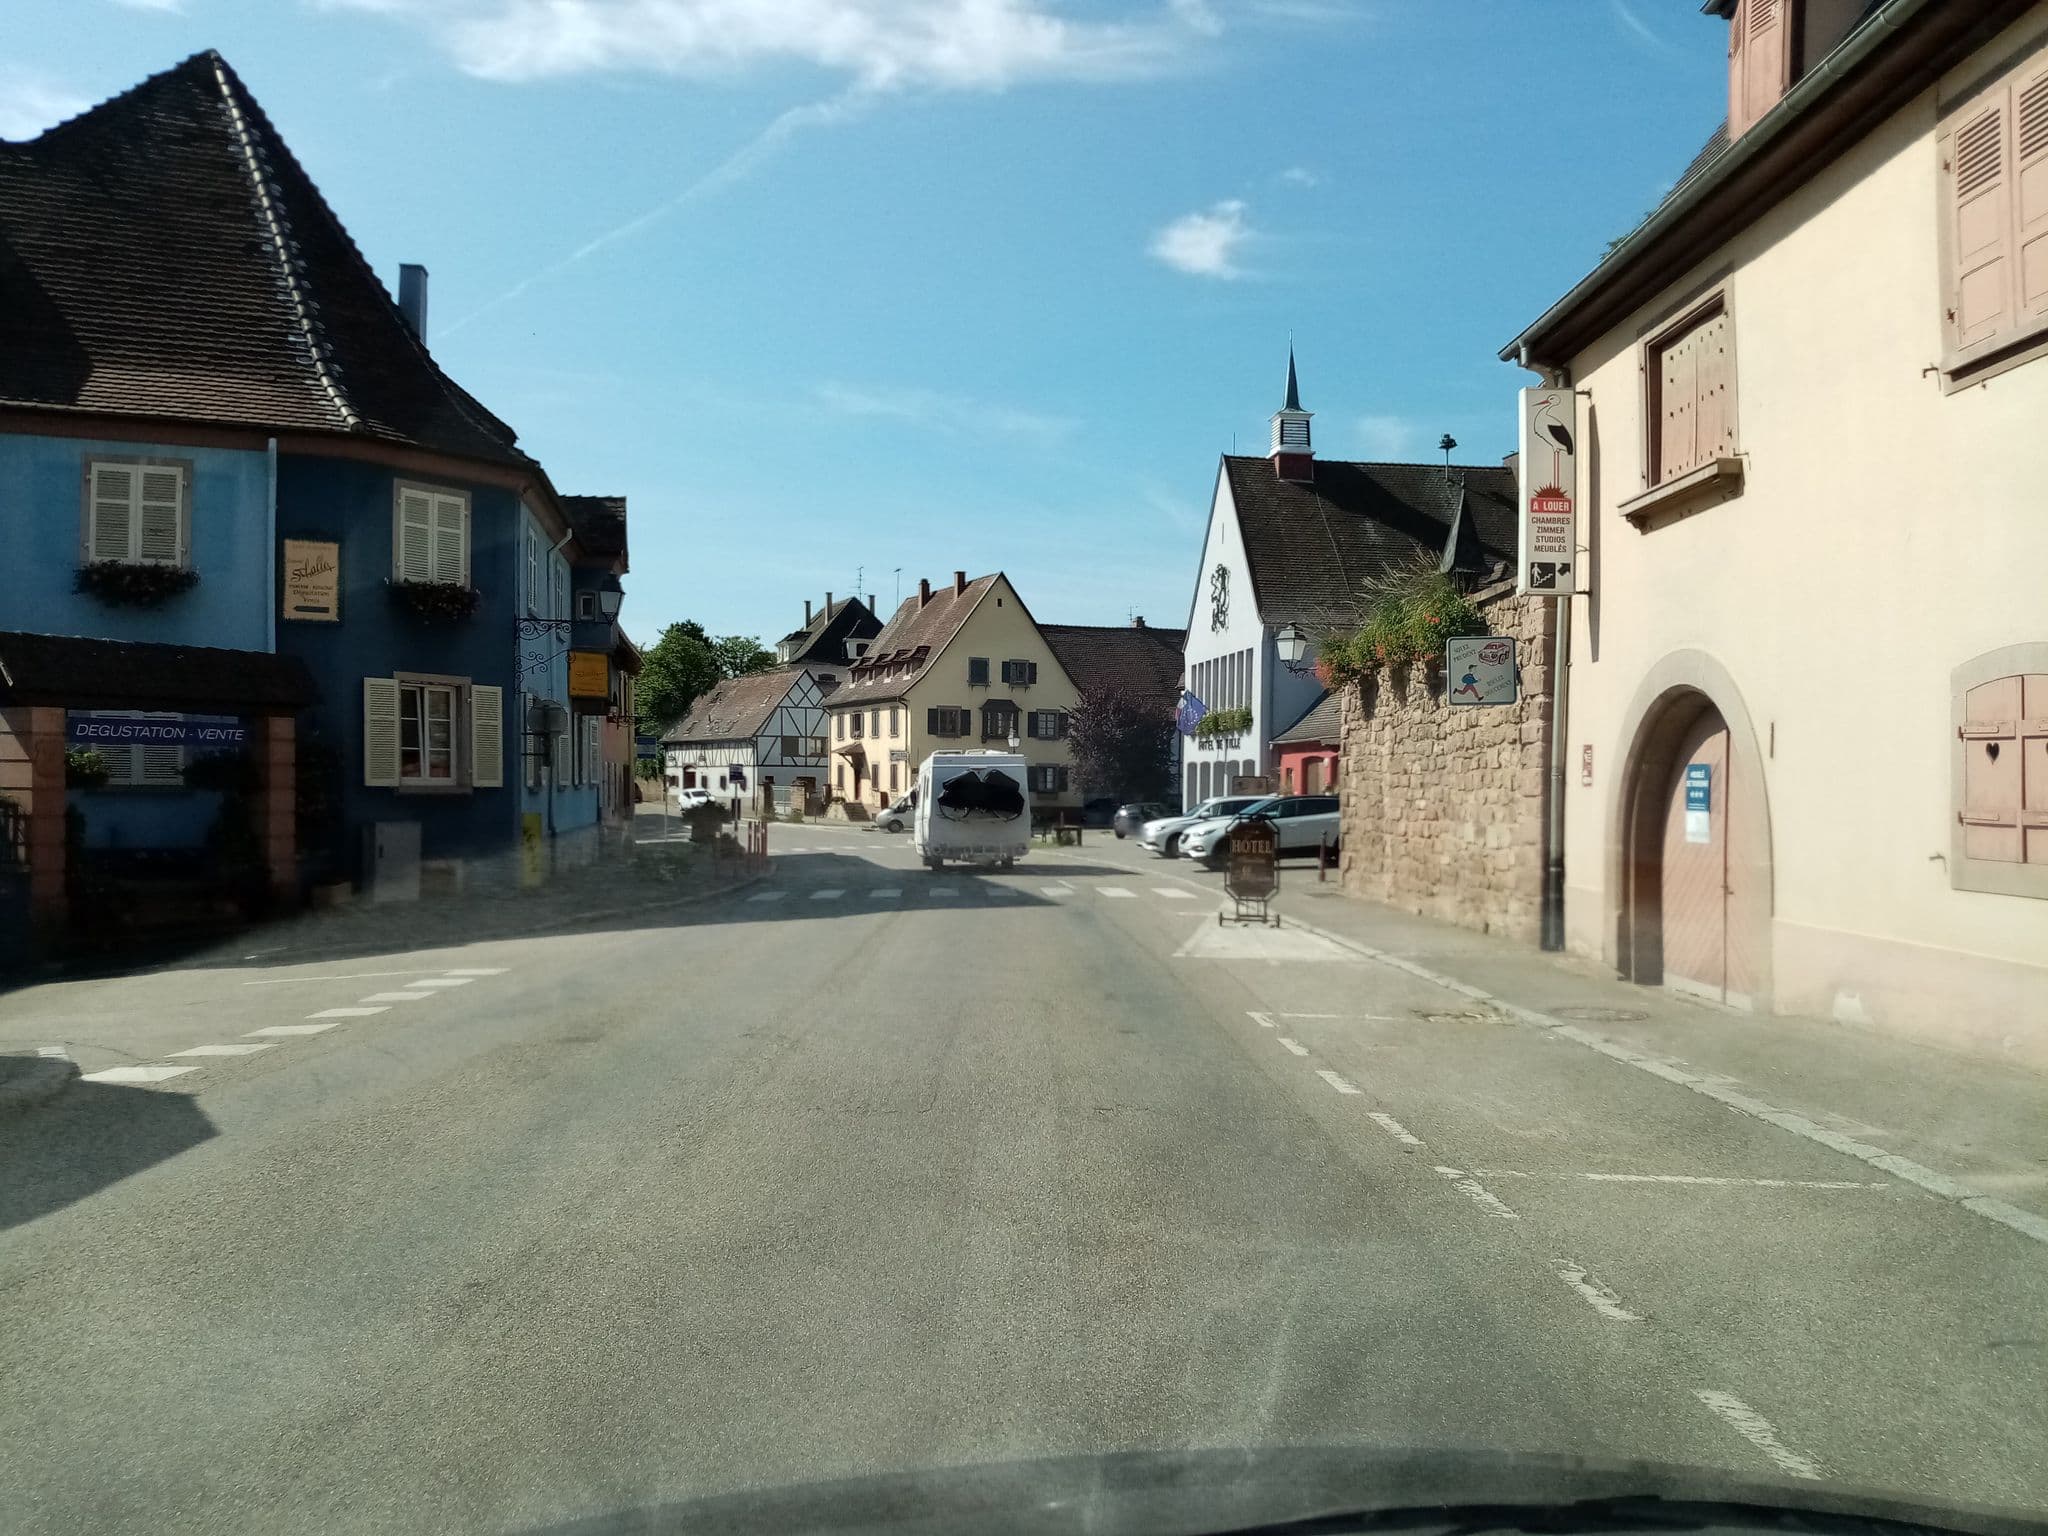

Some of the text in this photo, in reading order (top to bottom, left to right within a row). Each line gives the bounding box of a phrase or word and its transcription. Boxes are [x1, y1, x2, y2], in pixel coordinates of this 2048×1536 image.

[1533, 501, 1570, 511] A LOUER
[1531, 516, 1571, 525] CHAMBRES
[1536, 526, 1566, 534] ZIMMER
[1535, 535, 1566, 543] STUDIOS
[1533, 544, 1567, 552] MEUBLÉS
[76, 724, 187, 739] DEGUSTATION
[197, 728, 245, 741] VENTE
[1231, 839, 1272, 855] HOTEL
